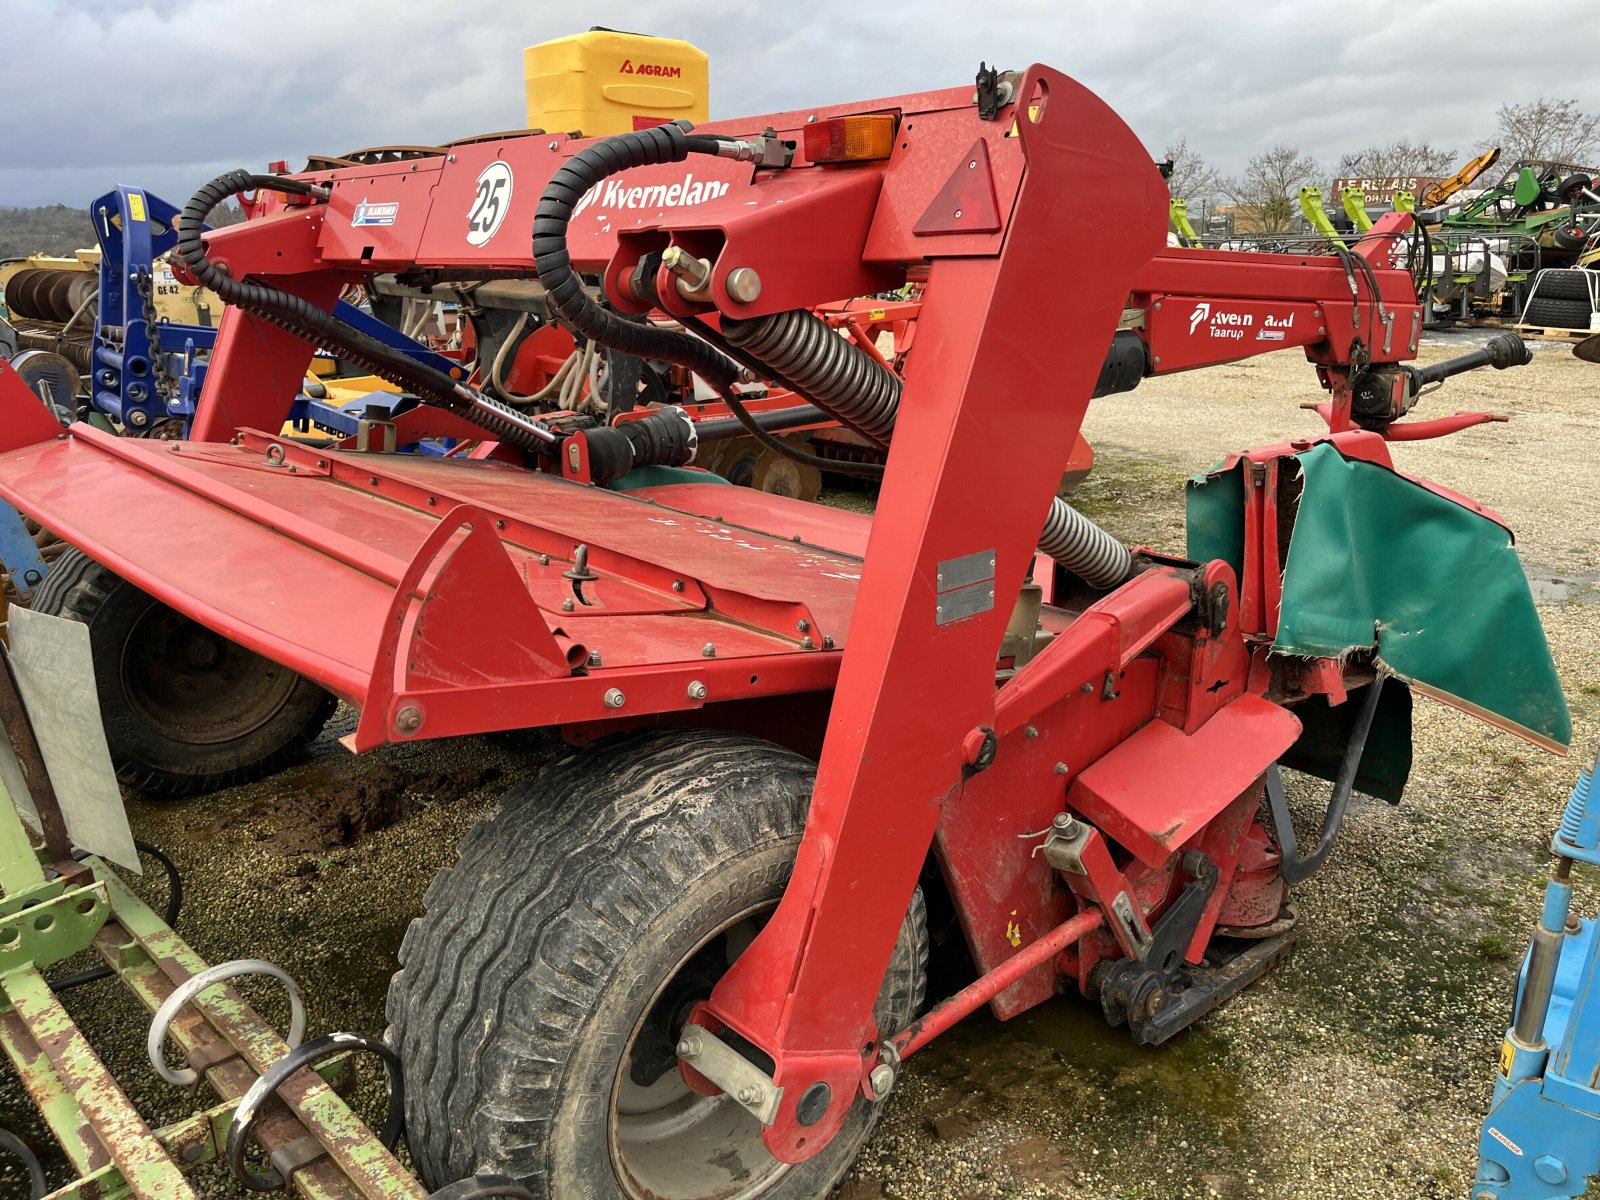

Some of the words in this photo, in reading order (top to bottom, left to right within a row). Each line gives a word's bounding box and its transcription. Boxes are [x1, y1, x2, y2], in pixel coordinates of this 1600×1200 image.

[636, 64, 681, 78] AGRAM
[601, 173, 730, 210] Kvernelan
[1361, 178, 1418, 191] RELAIS
[469, 178, 506, 233] 25
[157, 286, 168, 295] GE
[169, 285, 179, 294] 42
[1209, 326, 1244, 341] Taarup
